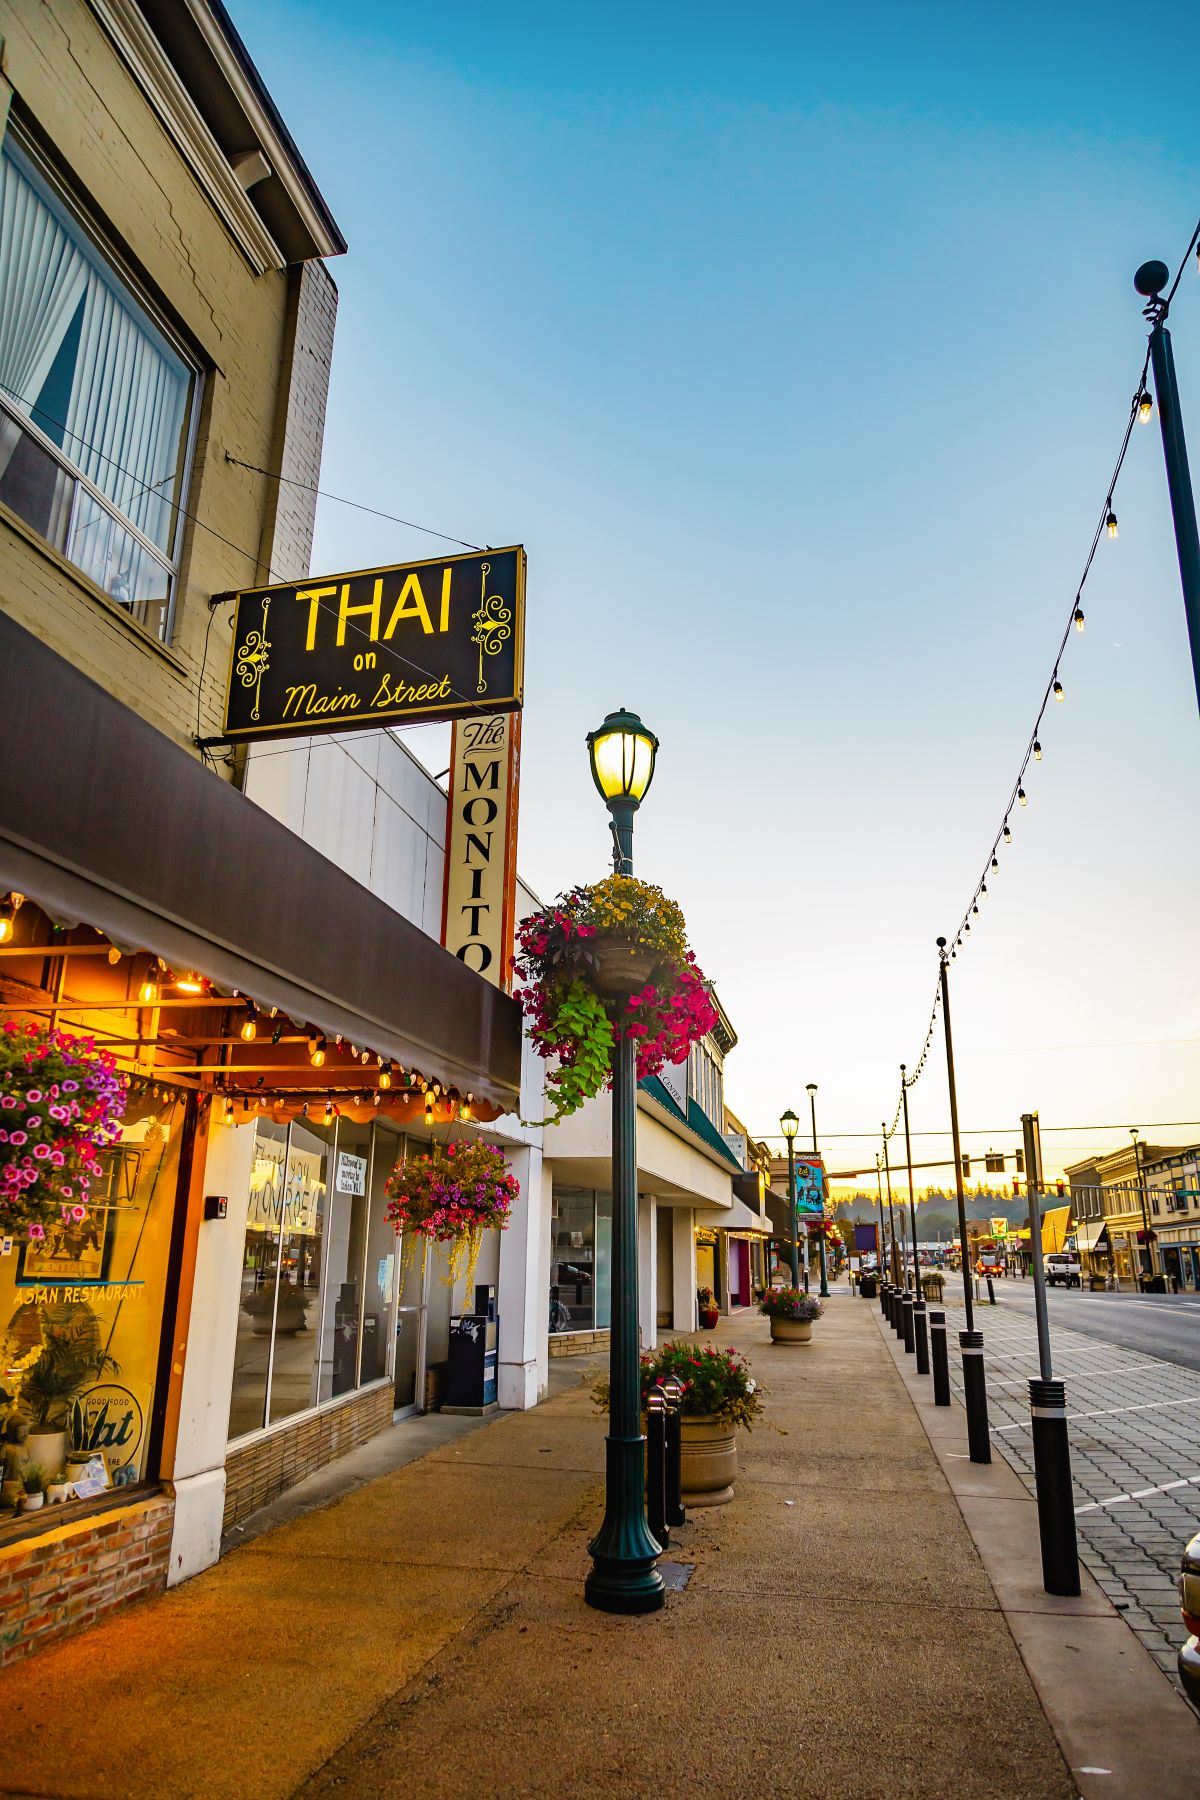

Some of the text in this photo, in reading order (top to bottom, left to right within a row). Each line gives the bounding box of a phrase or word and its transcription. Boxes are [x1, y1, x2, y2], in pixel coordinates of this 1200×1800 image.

[295, 567, 452, 651] THAI
[353, 651, 376, 672] on
[282, 673, 451, 718] Main Street
[463, 717, 505, 749] The
[662, 1076, 682, 1101] CENTER
[13, 1285, 145, 1304] ASIAN RESTAURANT
